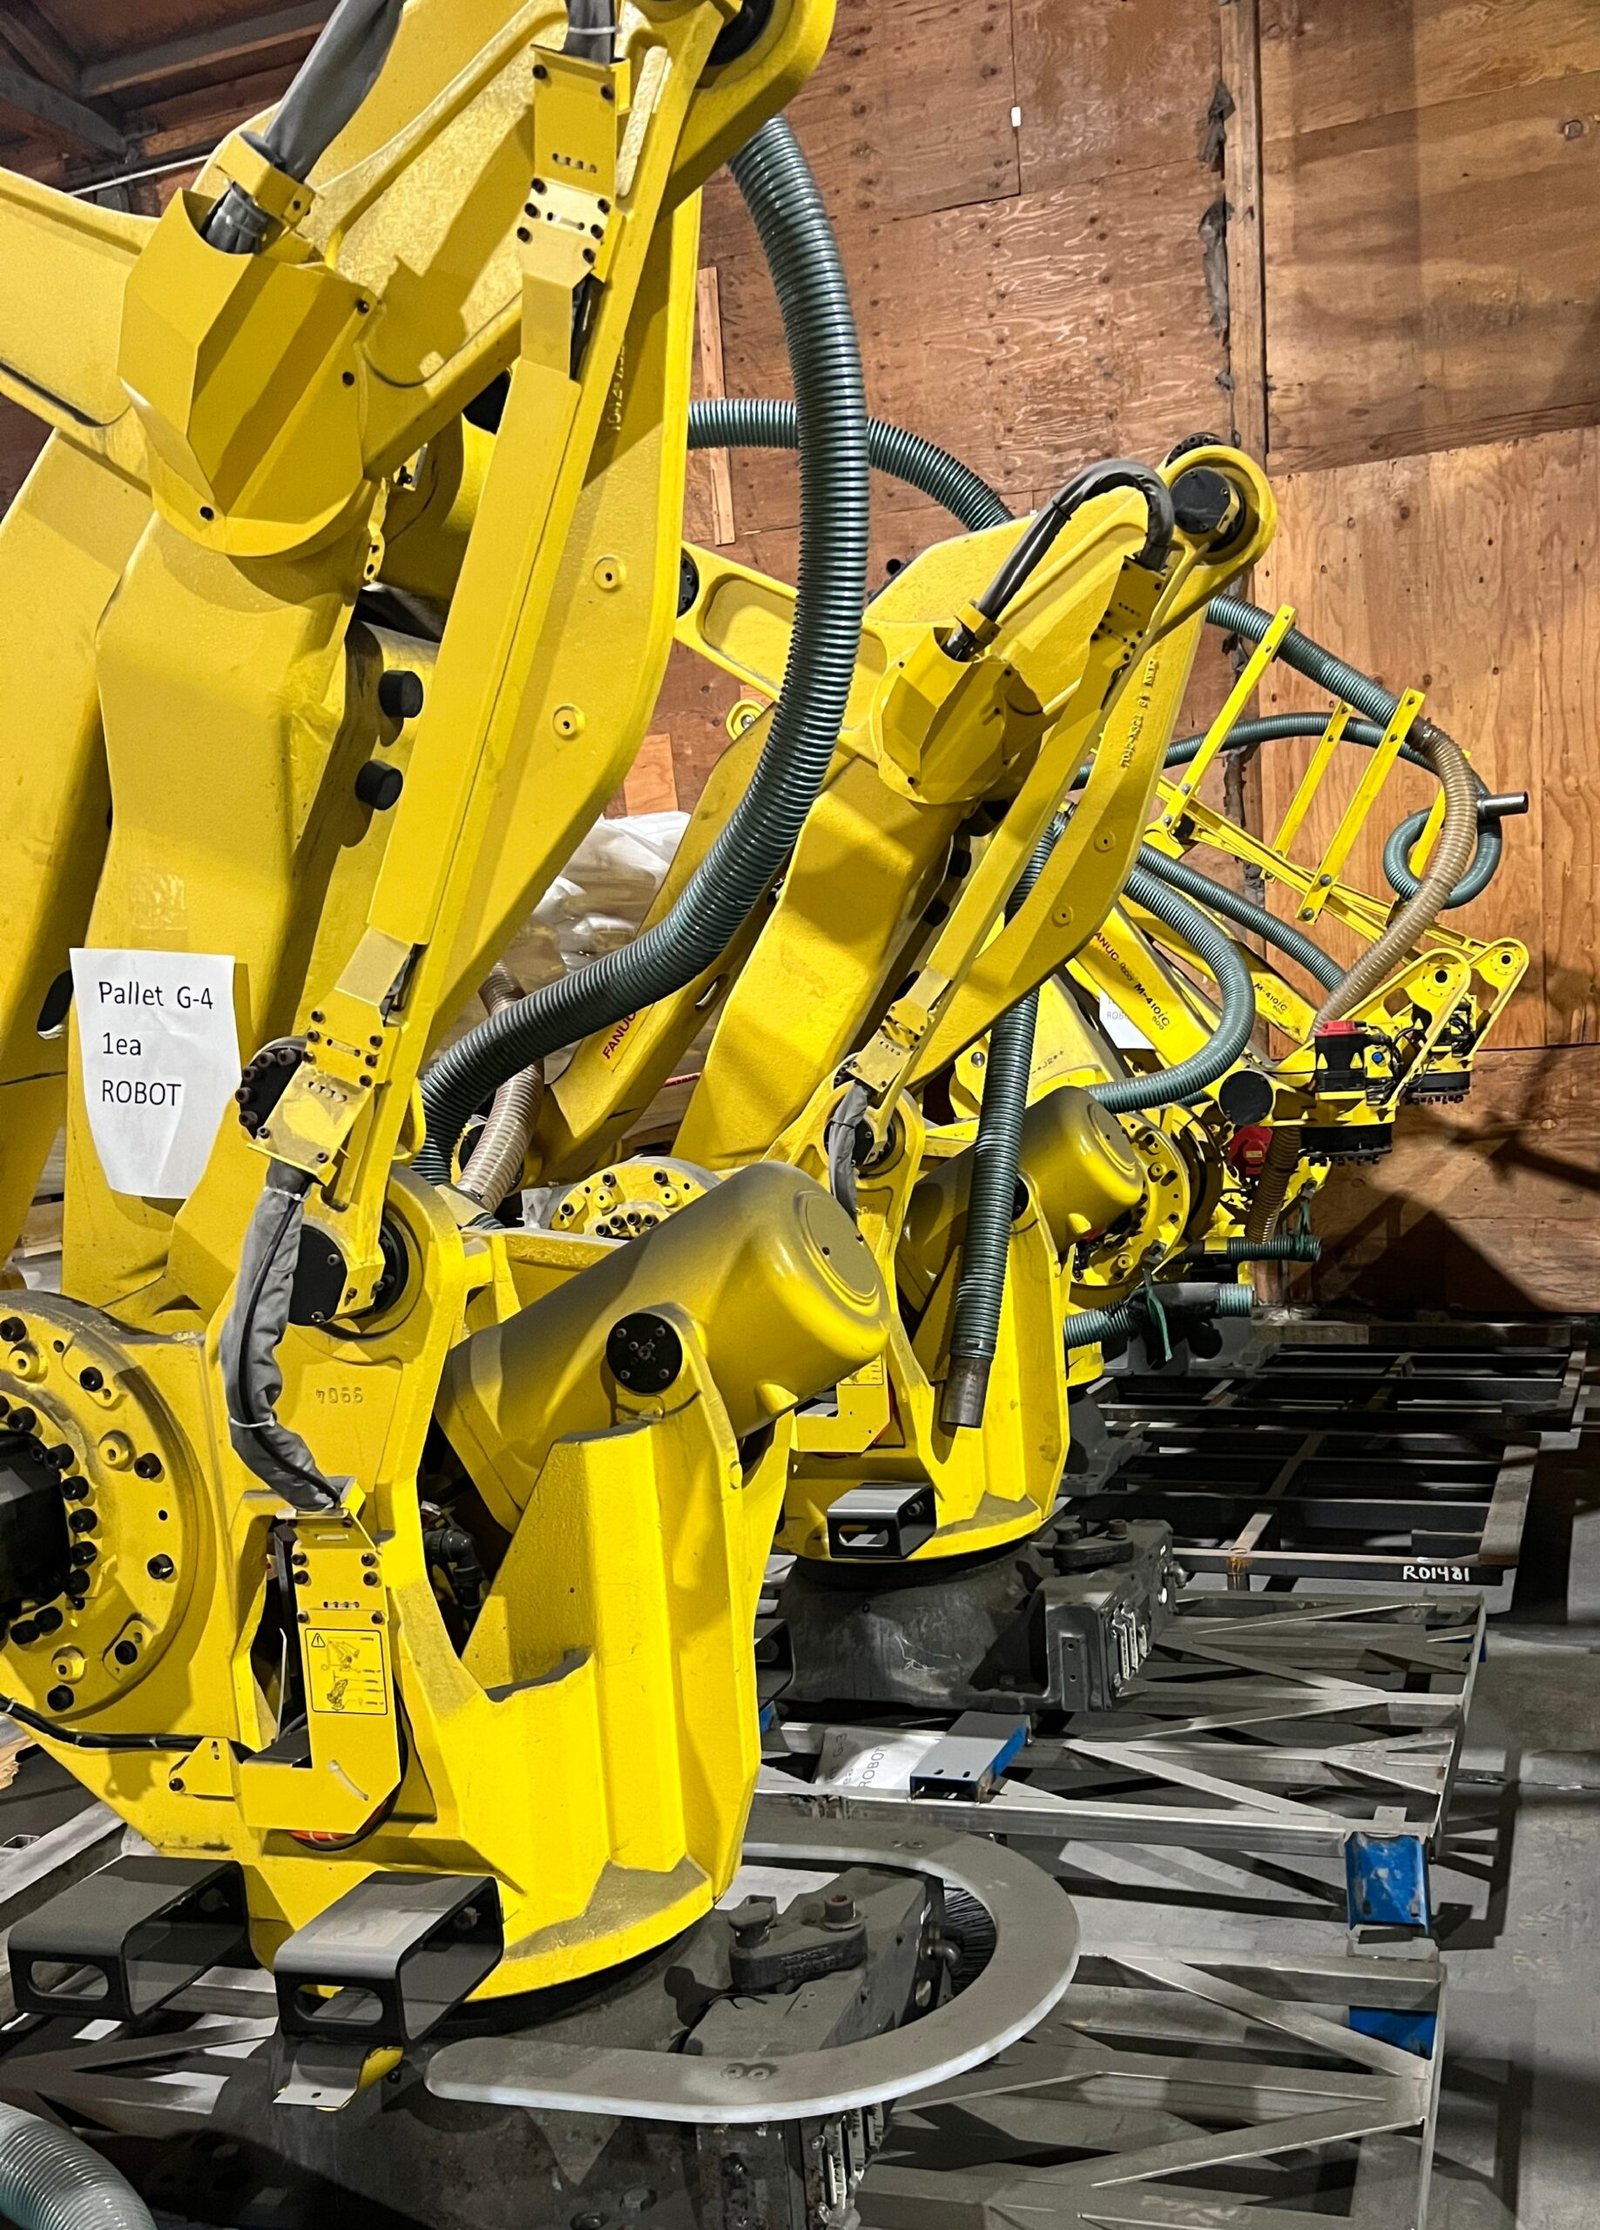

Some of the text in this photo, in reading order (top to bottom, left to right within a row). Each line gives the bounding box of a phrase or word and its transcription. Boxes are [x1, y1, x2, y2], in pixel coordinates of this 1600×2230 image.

[1095, 931, 1119, 961] ANUC
[98, 981, 213, 1009] Pallet G-4
[103, 1032, 142, 1056] 1ea
[102, 1080, 182, 1106] ROBOT
[859, 1747, 888, 1788] ROBOT
